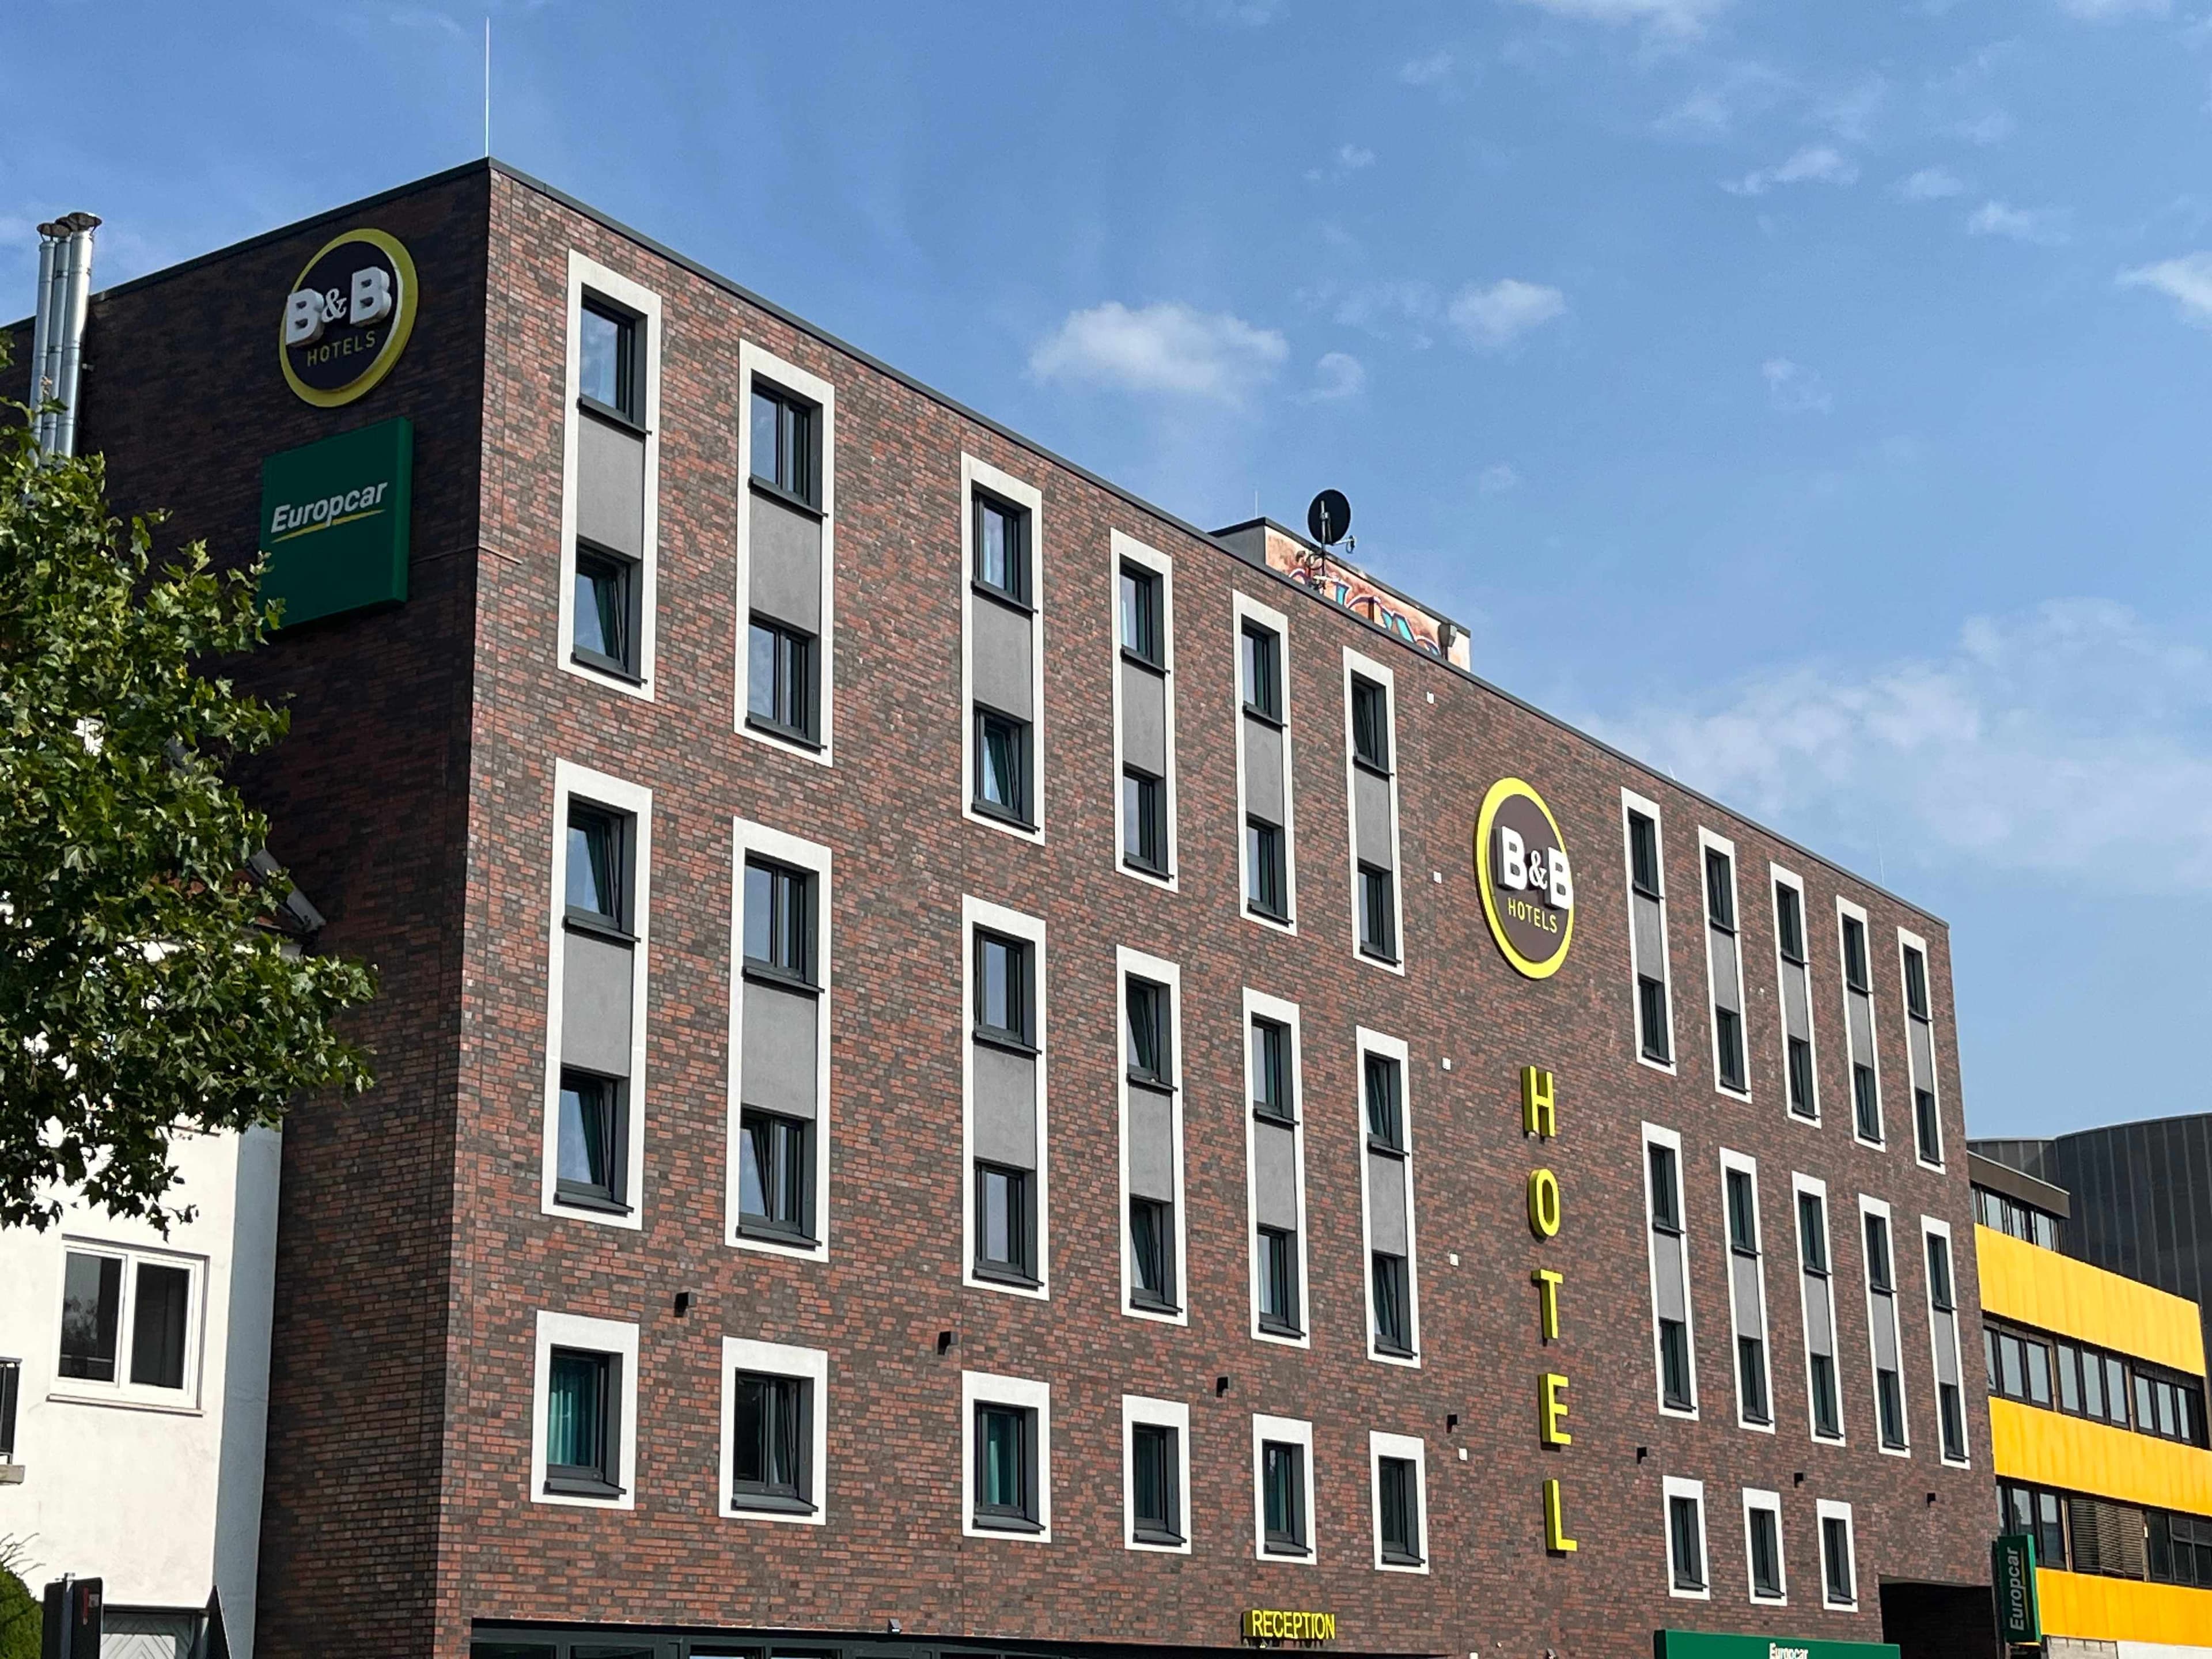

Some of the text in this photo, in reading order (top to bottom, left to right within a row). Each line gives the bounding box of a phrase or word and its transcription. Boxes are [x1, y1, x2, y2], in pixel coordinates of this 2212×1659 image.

[285, 266, 392, 346] B&B
[307, 331, 376, 366] HOTELS
[271, 482, 388, 533] Europcar
[1499, 825, 1574, 910] B&B
[1508, 897, 1557, 933] HOTELS
[1522, 1065, 1577, 1551] HOTEL
[2007, 1546, 2025, 1631] Europcar
[1251, 1609, 1336, 1639] RECEPTION
